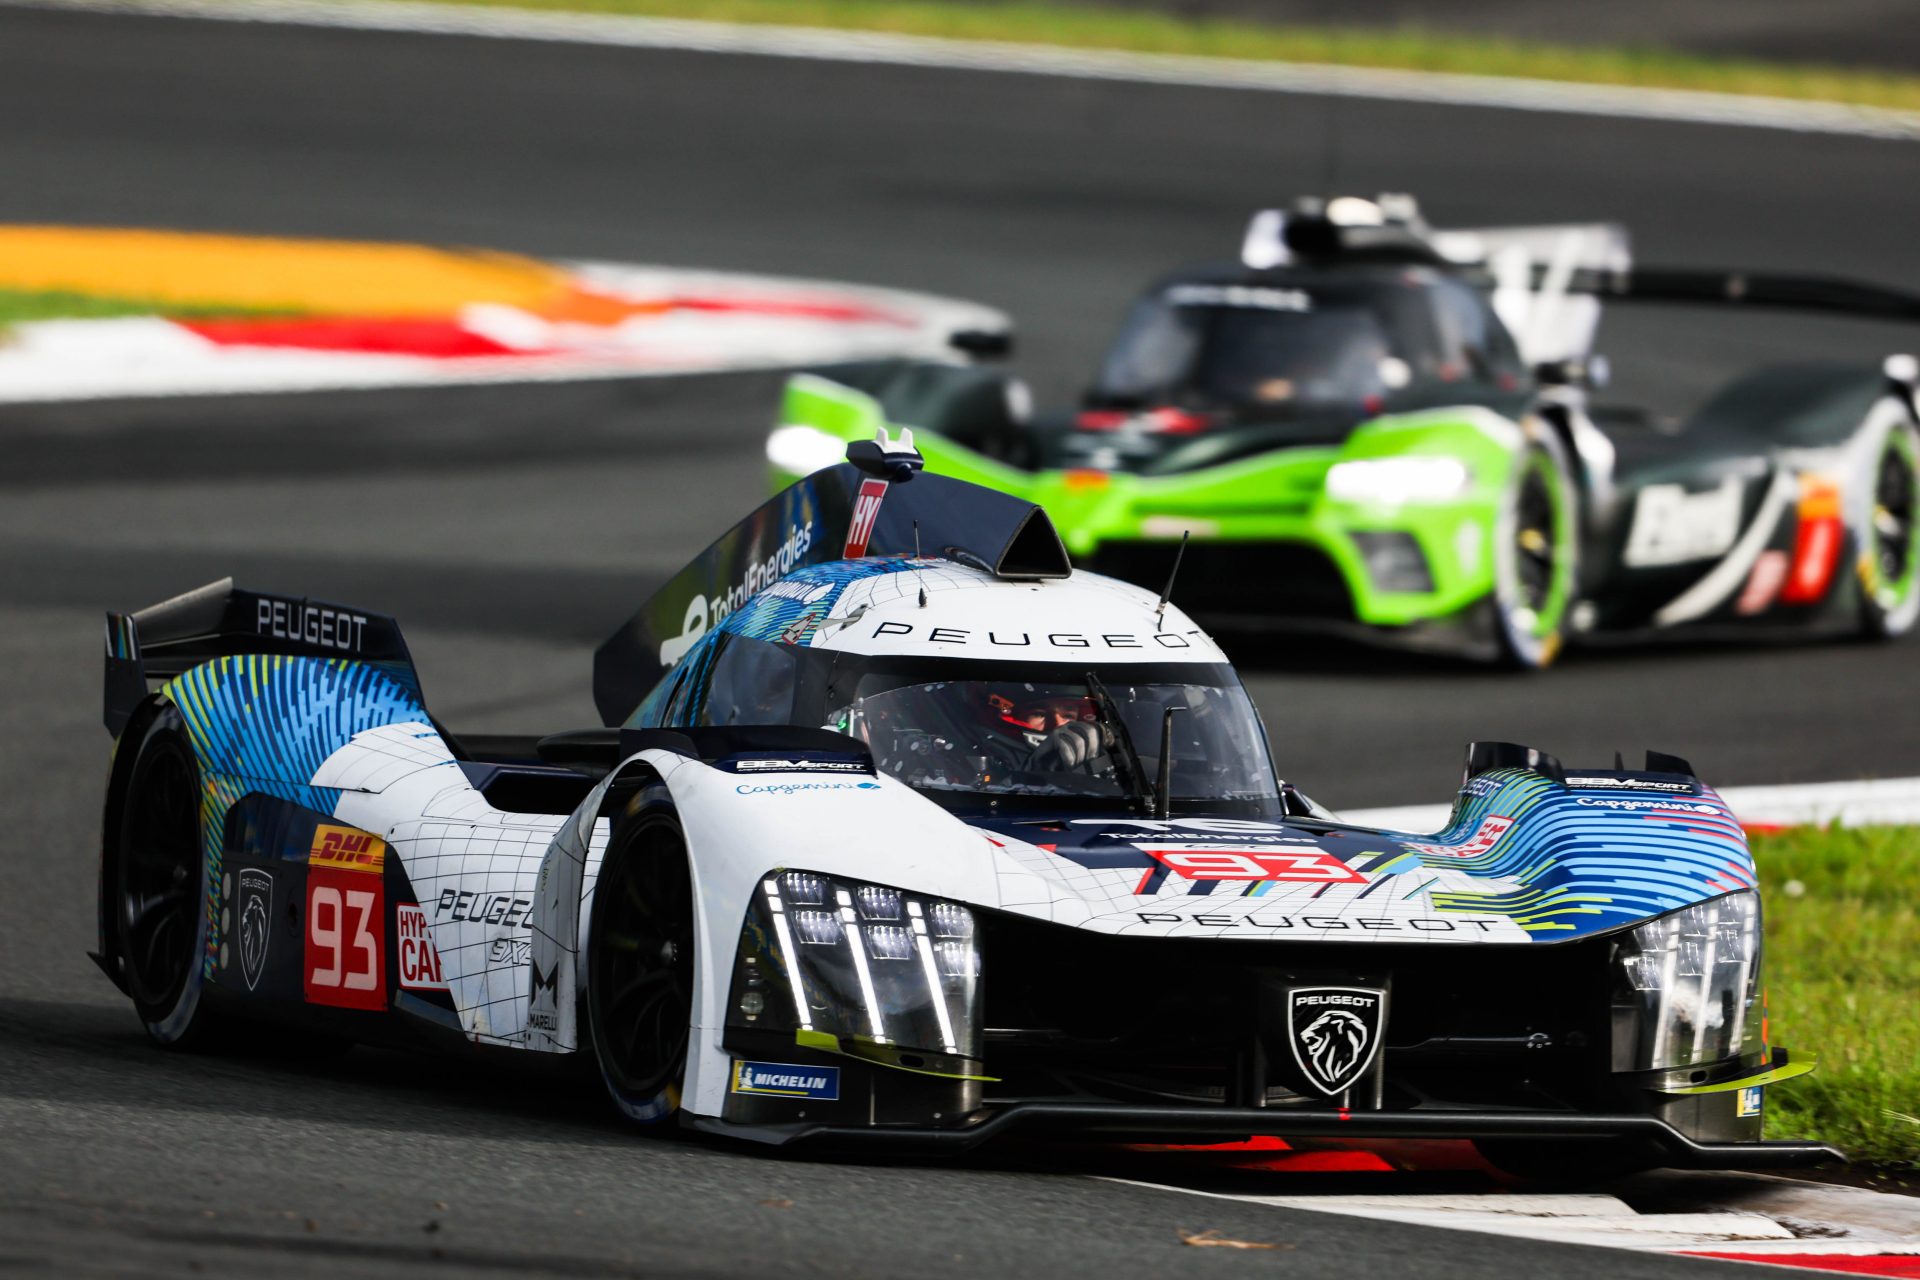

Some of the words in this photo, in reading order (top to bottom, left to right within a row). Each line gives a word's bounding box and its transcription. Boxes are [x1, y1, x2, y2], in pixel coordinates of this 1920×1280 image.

[848, 495, 881, 546] HY
[257, 599, 366, 651] PEUGEOT
[736, 781, 854, 795] Capgemini
[1576, 797, 1694, 811] Capgemini
[1099, 833, 1318, 843] TotalEnergies
[319, 832, 373, 863] DHL
[1162, 853, 1353, 878] 93
[241, 878, 270, 892] PEUGEOT
[400, 911, 432, 939] HYP
[1136, 912, 1497, 931] PEUGEOT
[311, 886, 377, 991] 93
[1296, 995, 1375, 1007] PEUGEOT
[529, 1013, 557, 1031] MARELLI
[754, 1073, 827, 1089] MICHELIN
